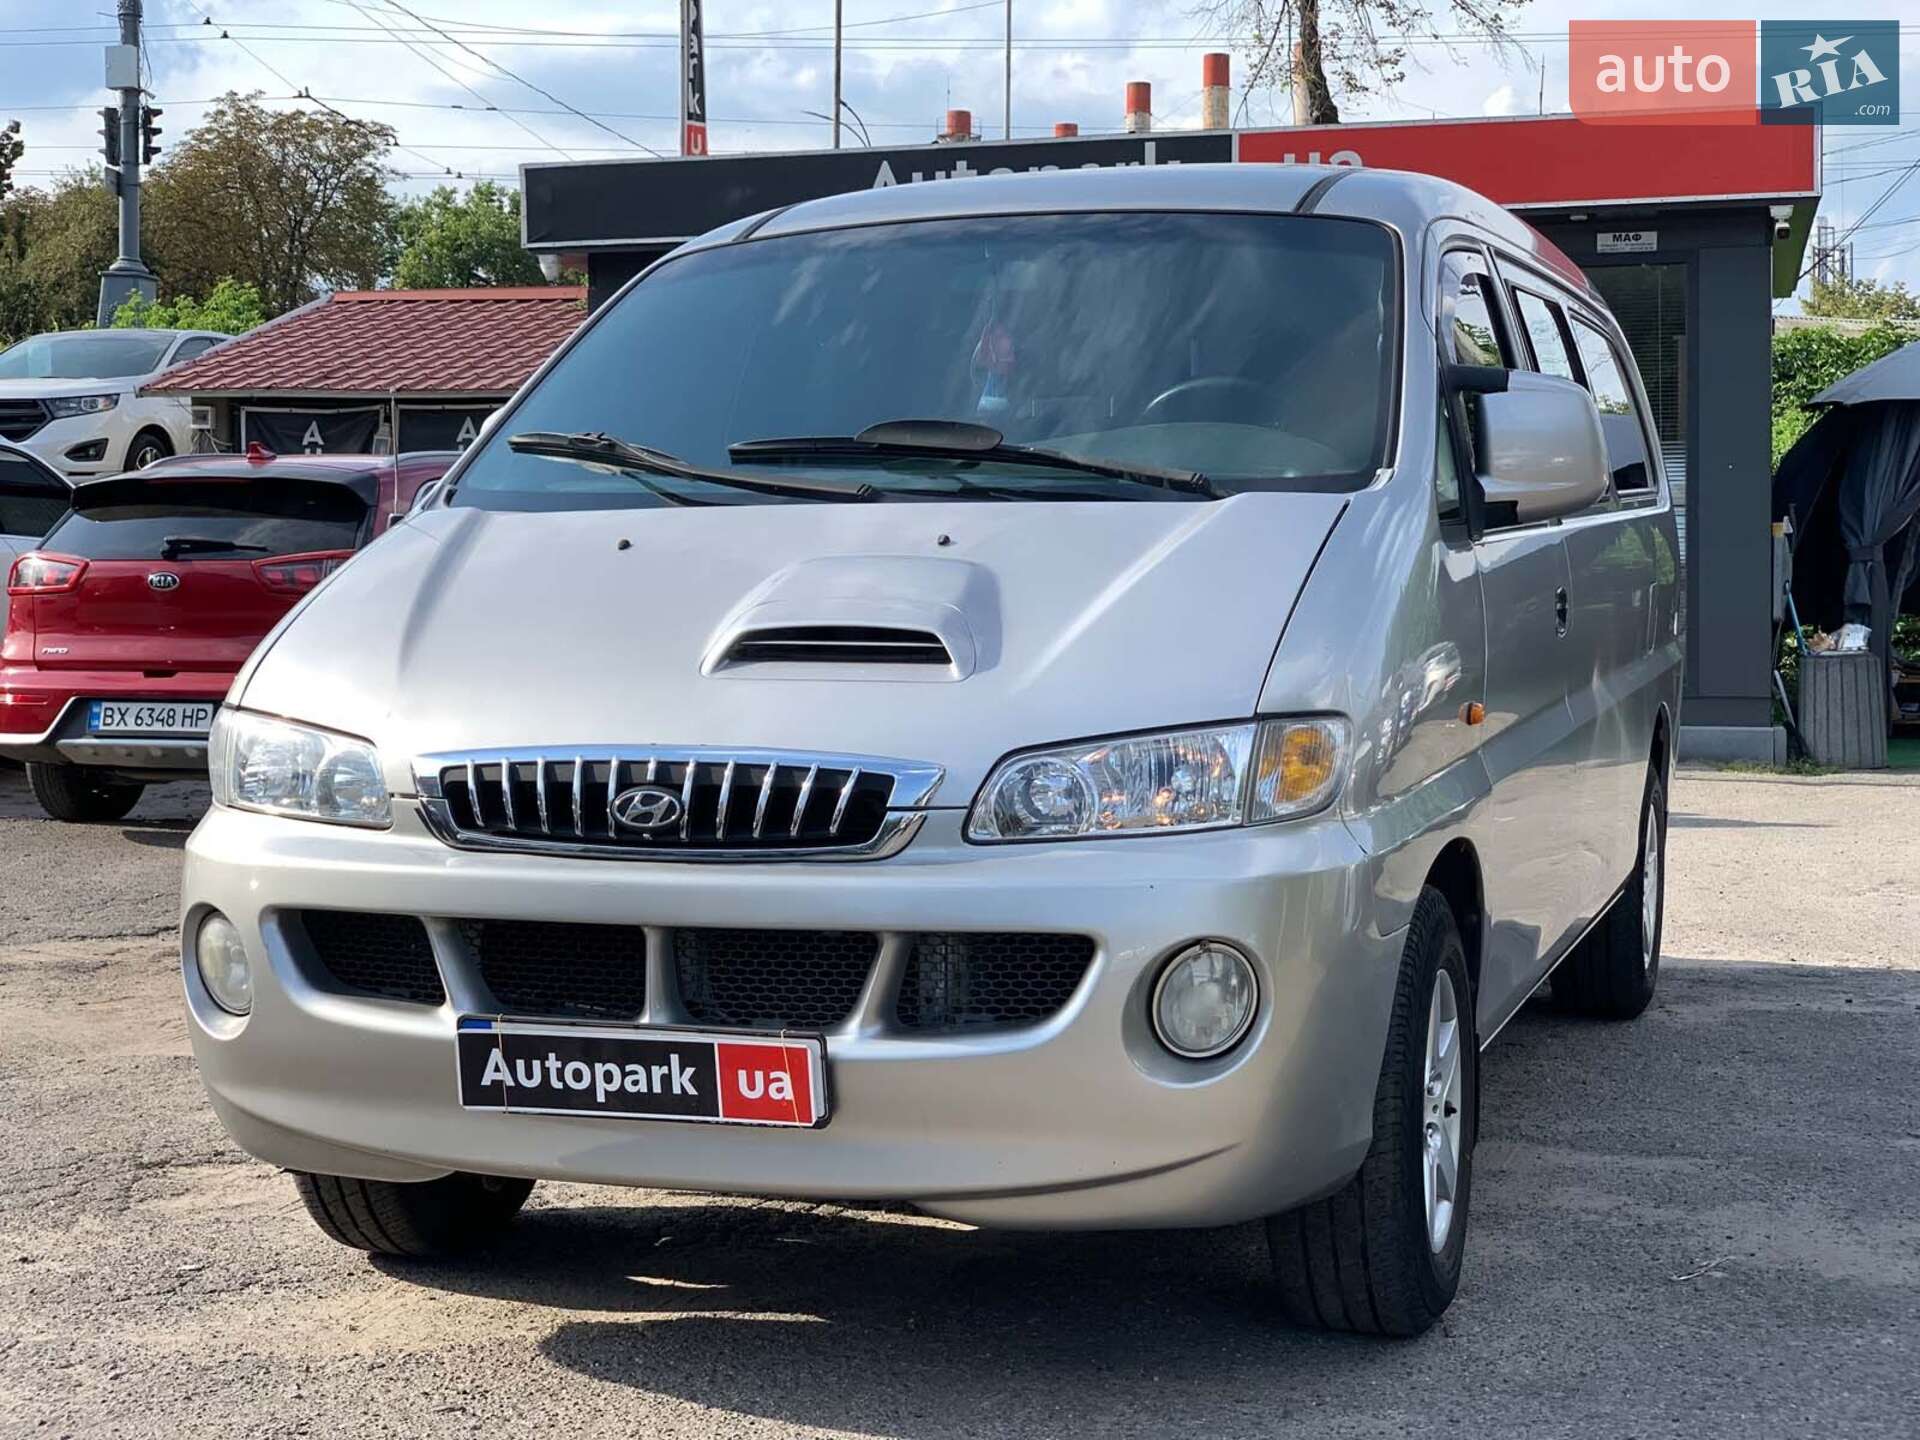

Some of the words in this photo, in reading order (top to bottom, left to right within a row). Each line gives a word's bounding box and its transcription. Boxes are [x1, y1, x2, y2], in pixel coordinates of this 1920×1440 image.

[1612, 233, 1642, 242] МАФ
[152, 575, 174, 587] KIA
[102, 707, 130, 727] BX
[134, 707, 177, 728] 6348
[181, 707, 209, 728] HP
[480, 1048, 699, 1103] Autopark
[737, 1066, 794, 1102] ua
